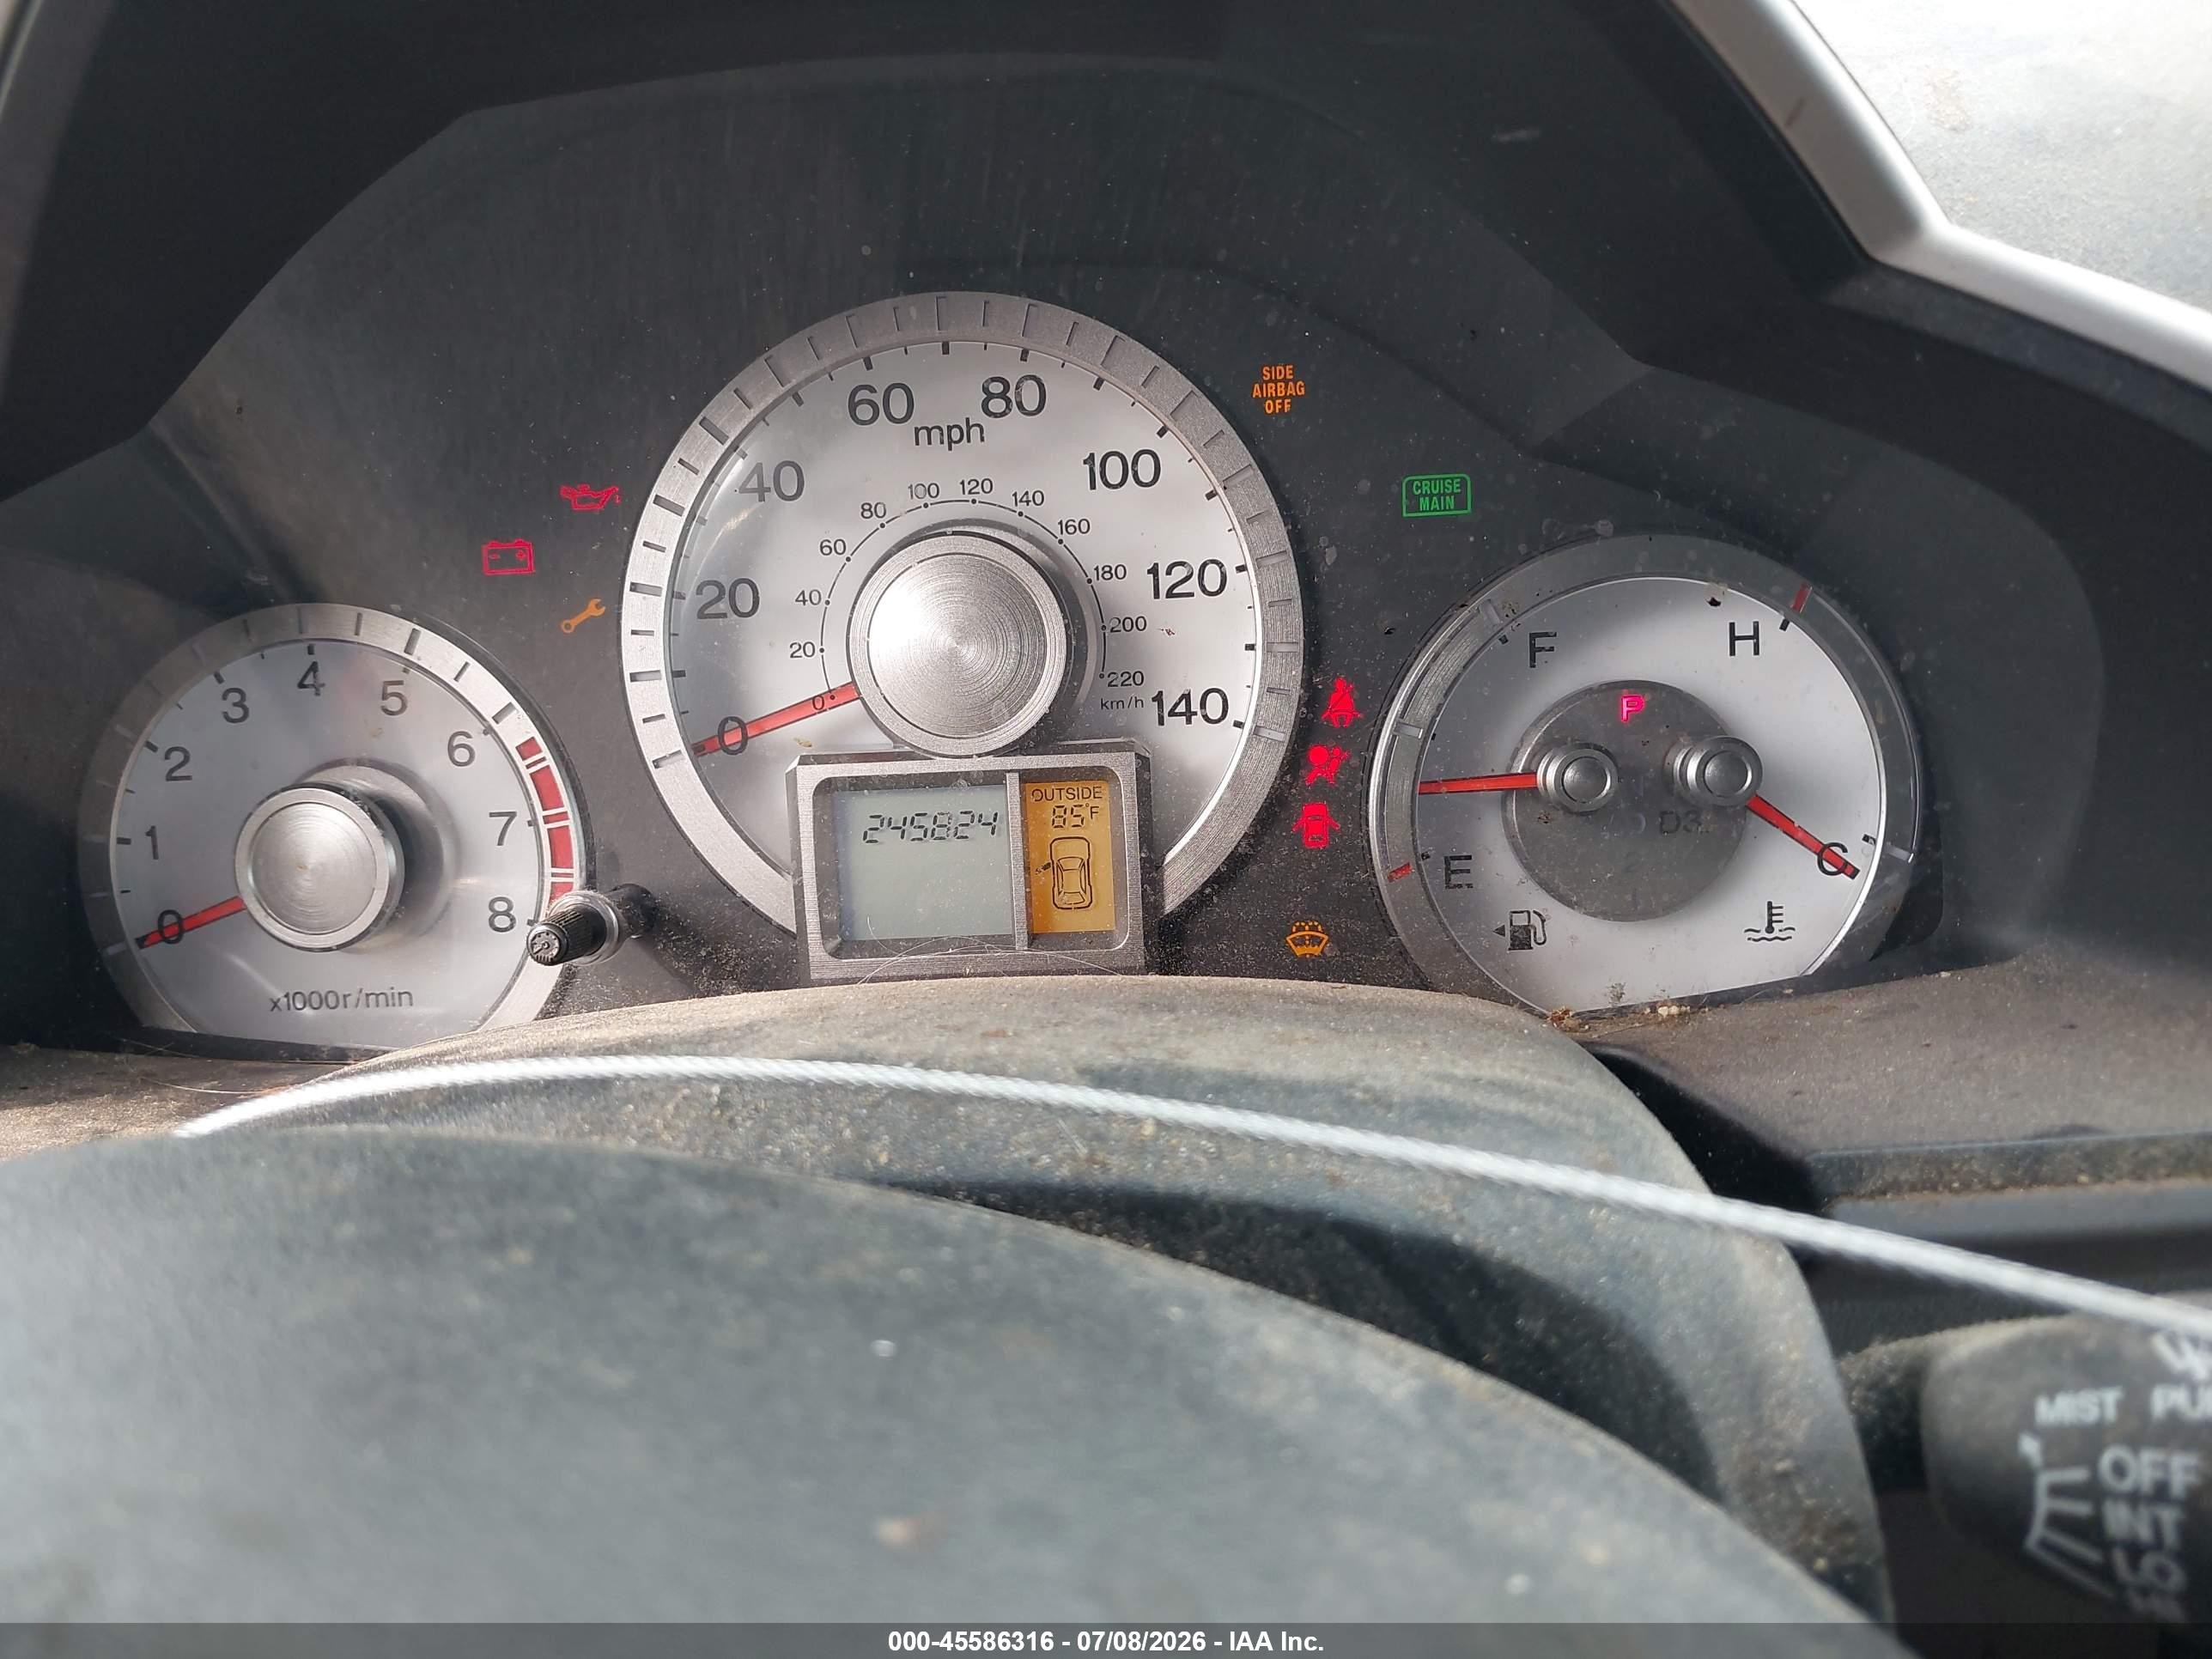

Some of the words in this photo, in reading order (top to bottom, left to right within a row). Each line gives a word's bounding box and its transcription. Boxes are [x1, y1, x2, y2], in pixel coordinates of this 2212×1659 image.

[1252, 381, 1305, 398] AIRBAG
[1262, 365, 1293, 380] SIDE
[848, 381, 915, 426] 60
[981, 375, 1047, 419] 80
[1265, 399, 1291, 414] OFF
[913, 419, 985, 452] mph
[738, 460, 805, 503] 40
[959, 478, 994, 495] 120
[1083, 449, 1162, 489] 100
[908, 482, 940, 501] 100
[1011, 489, 1045, 508] 140
[1413, 479, 1462, 495] CRUISE
[1419, 495, 1455, 511] MAIN
[860, 502, 887, 520] 80
[1057, 518, 1091, 536] 160
[819, 538, 847, 557] 60
[1095, 563, 1127, 581] 180
[1146, 560, 1228, 600] 120
[696, 577, 761, 620] 20
[794, 588, 823, 606] 40
[1109, 616, 1148, 632] 200
[1728, 621, 1760, 657] H
[789, 641, 816, 659] 20
[1528, 632, 1558, 668] F
[297, 661, 325, 696] 4
[1106, 670, 1146, 687] 220
[221, 688, 250, 724] 3
[380, 680, 409, 715] 5
[812, 695, 827, 711] 0
[1099, 696, 1146, 710] km/h
[1152, 687, 1230, 726] 140
[1620, 694, 1644, 722] P
[447, 731, 476, 767] 6
[718, 716, 748, 755] 0
[163, 746, 193, 782] 2
[1031, 785, 1103, 802] OUTSIDE
[144, 825, 160, 860] 1
[489, 811, 517, 847] 7
[862, 810, 998, 845] 245824
[1444, 854, 1474, 890] E
[1816, 842, 1850, 877] C
[157, 910, 185, 945] 0
[488, 896, 517, 933] 8
[269, 988, 415, 1013] x1000r/min
[2035, 1387, 2123, 1425] MIST
[2097, 1443, 2202, 1501] OFF
